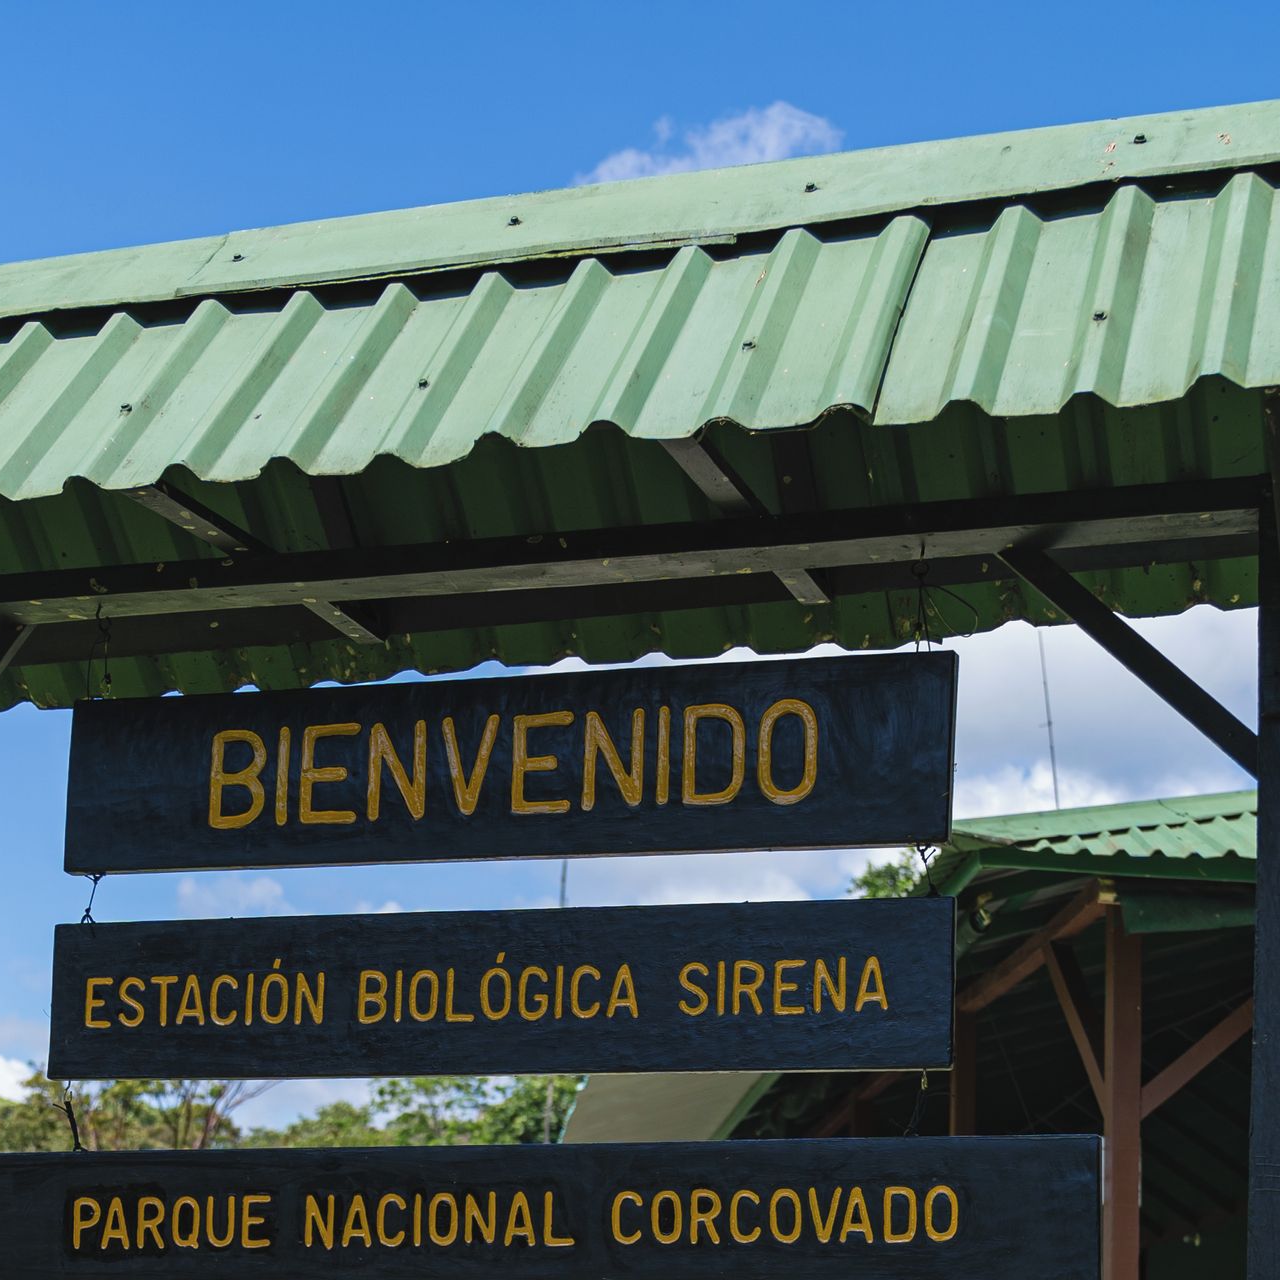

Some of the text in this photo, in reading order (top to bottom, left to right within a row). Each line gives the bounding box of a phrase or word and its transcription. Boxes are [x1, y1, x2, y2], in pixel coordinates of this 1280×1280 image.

[209, 699, 818, 829] BIENVENIDO
[86, 952, 889, 1029] ESTACIÓN BIOLÓGICA SIRENA
[73, 1185, 959, 1250] PARQUE NACIONAL CORCOVADO
